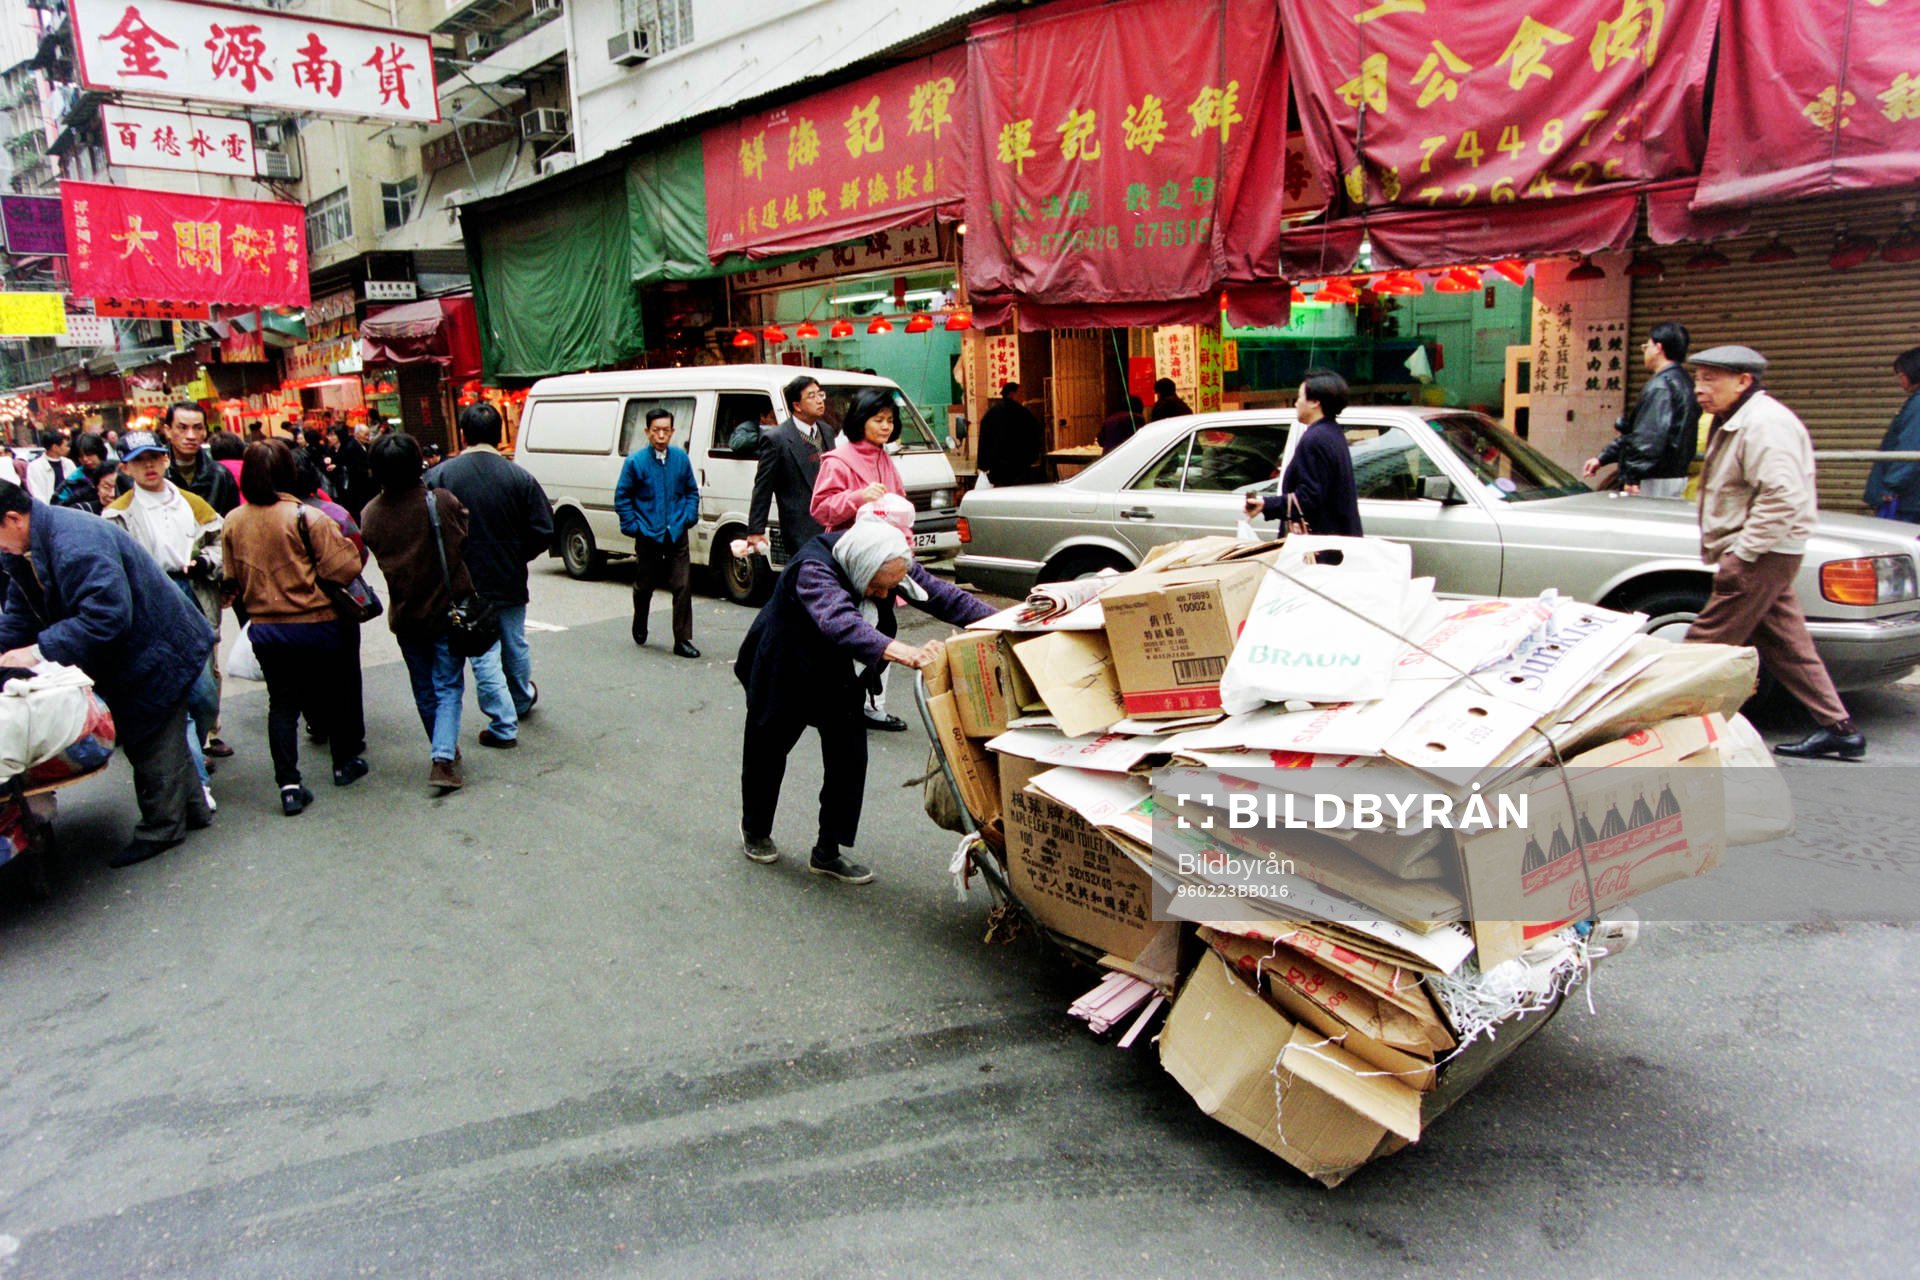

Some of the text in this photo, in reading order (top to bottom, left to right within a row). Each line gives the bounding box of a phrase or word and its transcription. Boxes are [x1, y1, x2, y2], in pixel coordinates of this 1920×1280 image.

[100, 5, 416, 110] 金源南貨
[996, 80, 1242, 175] 輝記海鮮
[1248, 645, 1361, 667] BRAUN
[1011, 791, 1099, 831] 楓葉牌衛
[1078, 831, 1104, 852] TOILET
